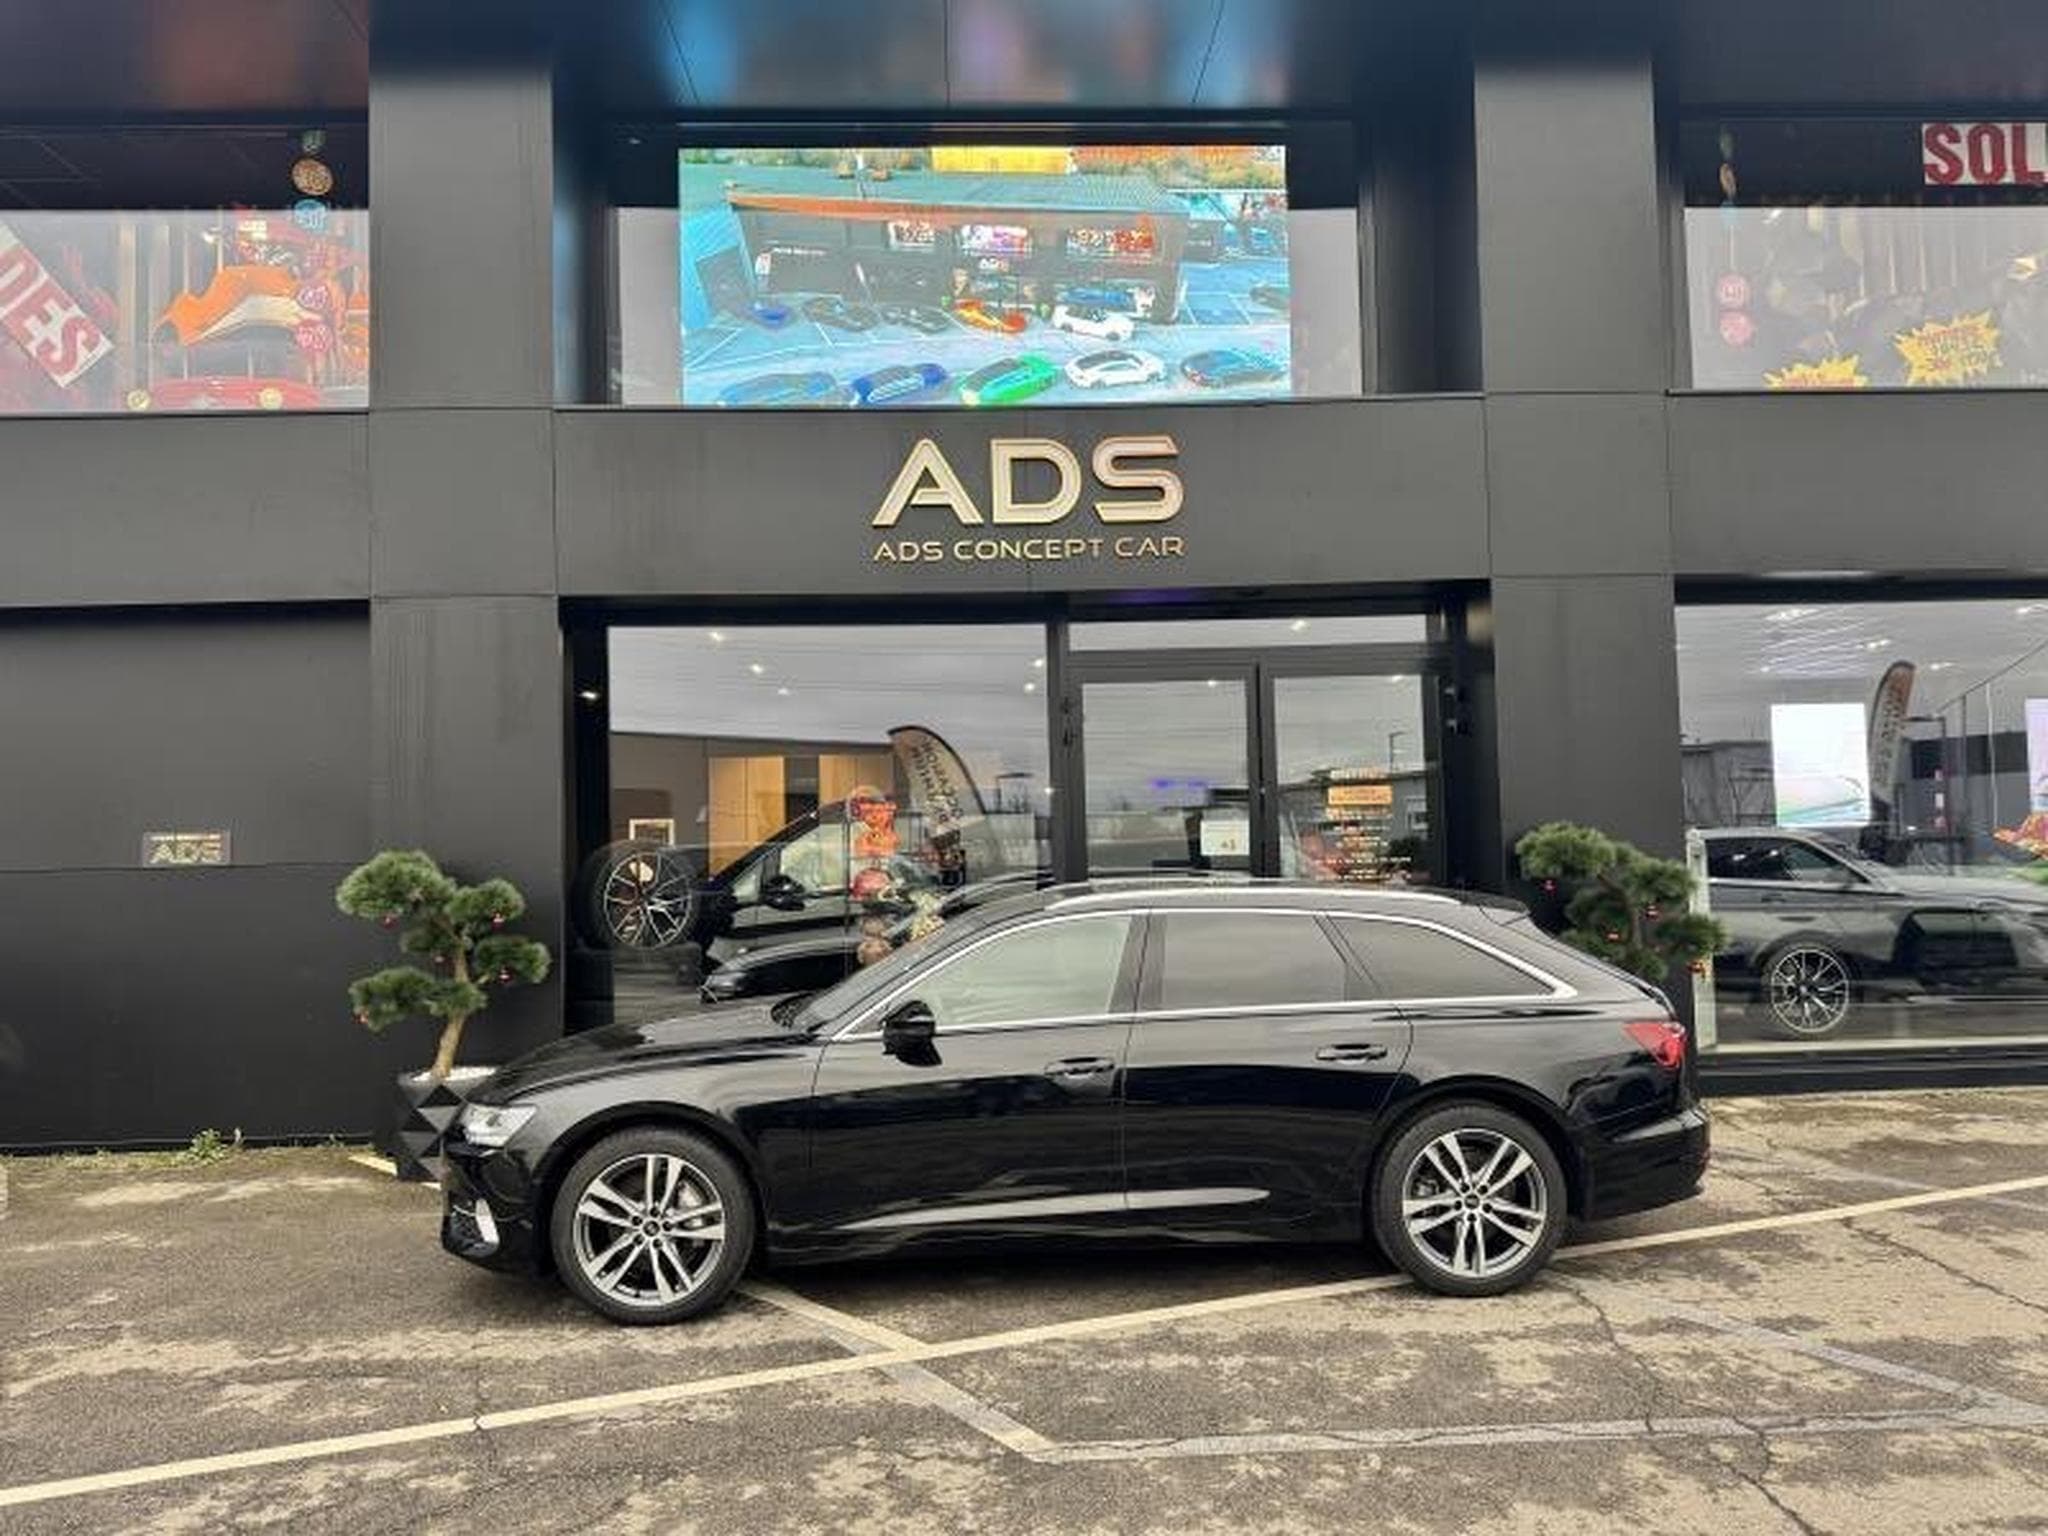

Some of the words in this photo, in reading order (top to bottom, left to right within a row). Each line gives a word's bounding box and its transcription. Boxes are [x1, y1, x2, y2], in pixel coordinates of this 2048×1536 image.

[872, 436, 1185, 526] ADS
[873, 541, 943, 562] ADS
[953, 538, 1104, 560] CONCEPT
[1114, 536, 1186, 557] CAR
